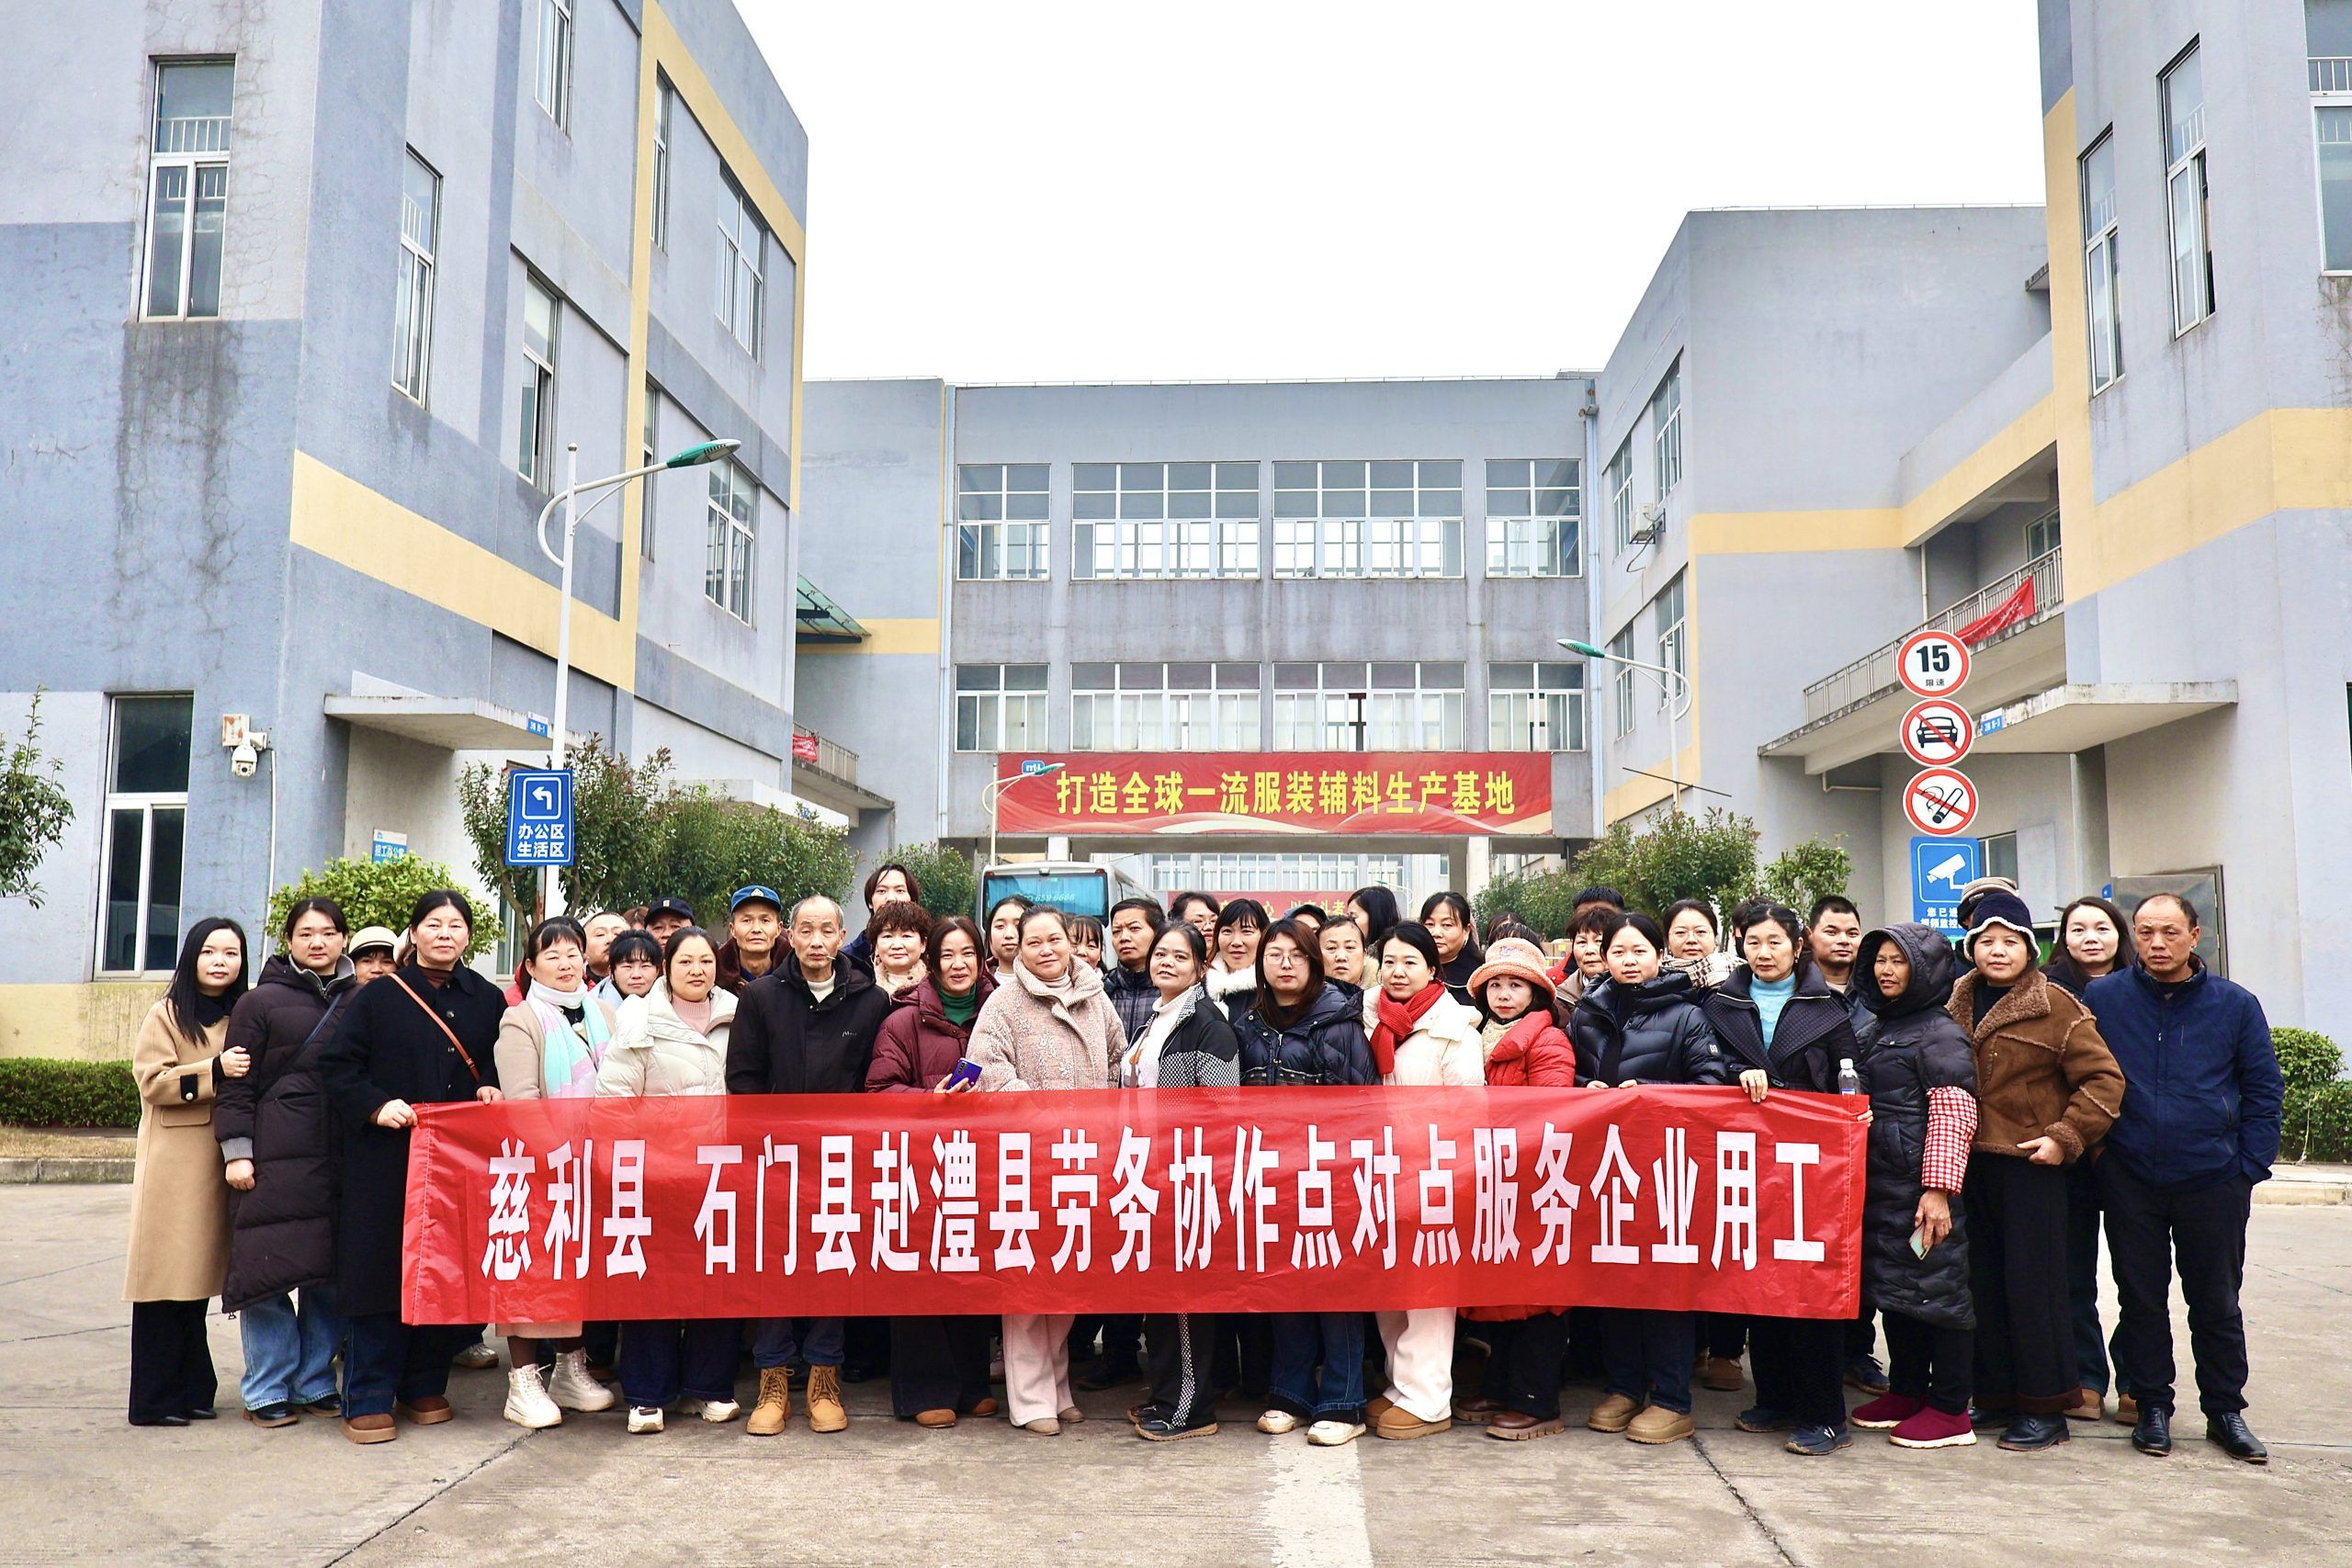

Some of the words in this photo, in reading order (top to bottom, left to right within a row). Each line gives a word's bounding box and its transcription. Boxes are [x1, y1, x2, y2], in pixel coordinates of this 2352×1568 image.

[1917, 645, 1950, 672] 15
[1057, 771, 1514, 815] 打造全球一流服装辅料生产基地
[518, 823, 565, 840] 办公区
[517, 841, 564, 858] 生活区
[481, 1137, 652, 1281] 慈利县
[694, 1122, 1826, 1276] 石门县赴澧县劳务协作点对点服务企业用工
